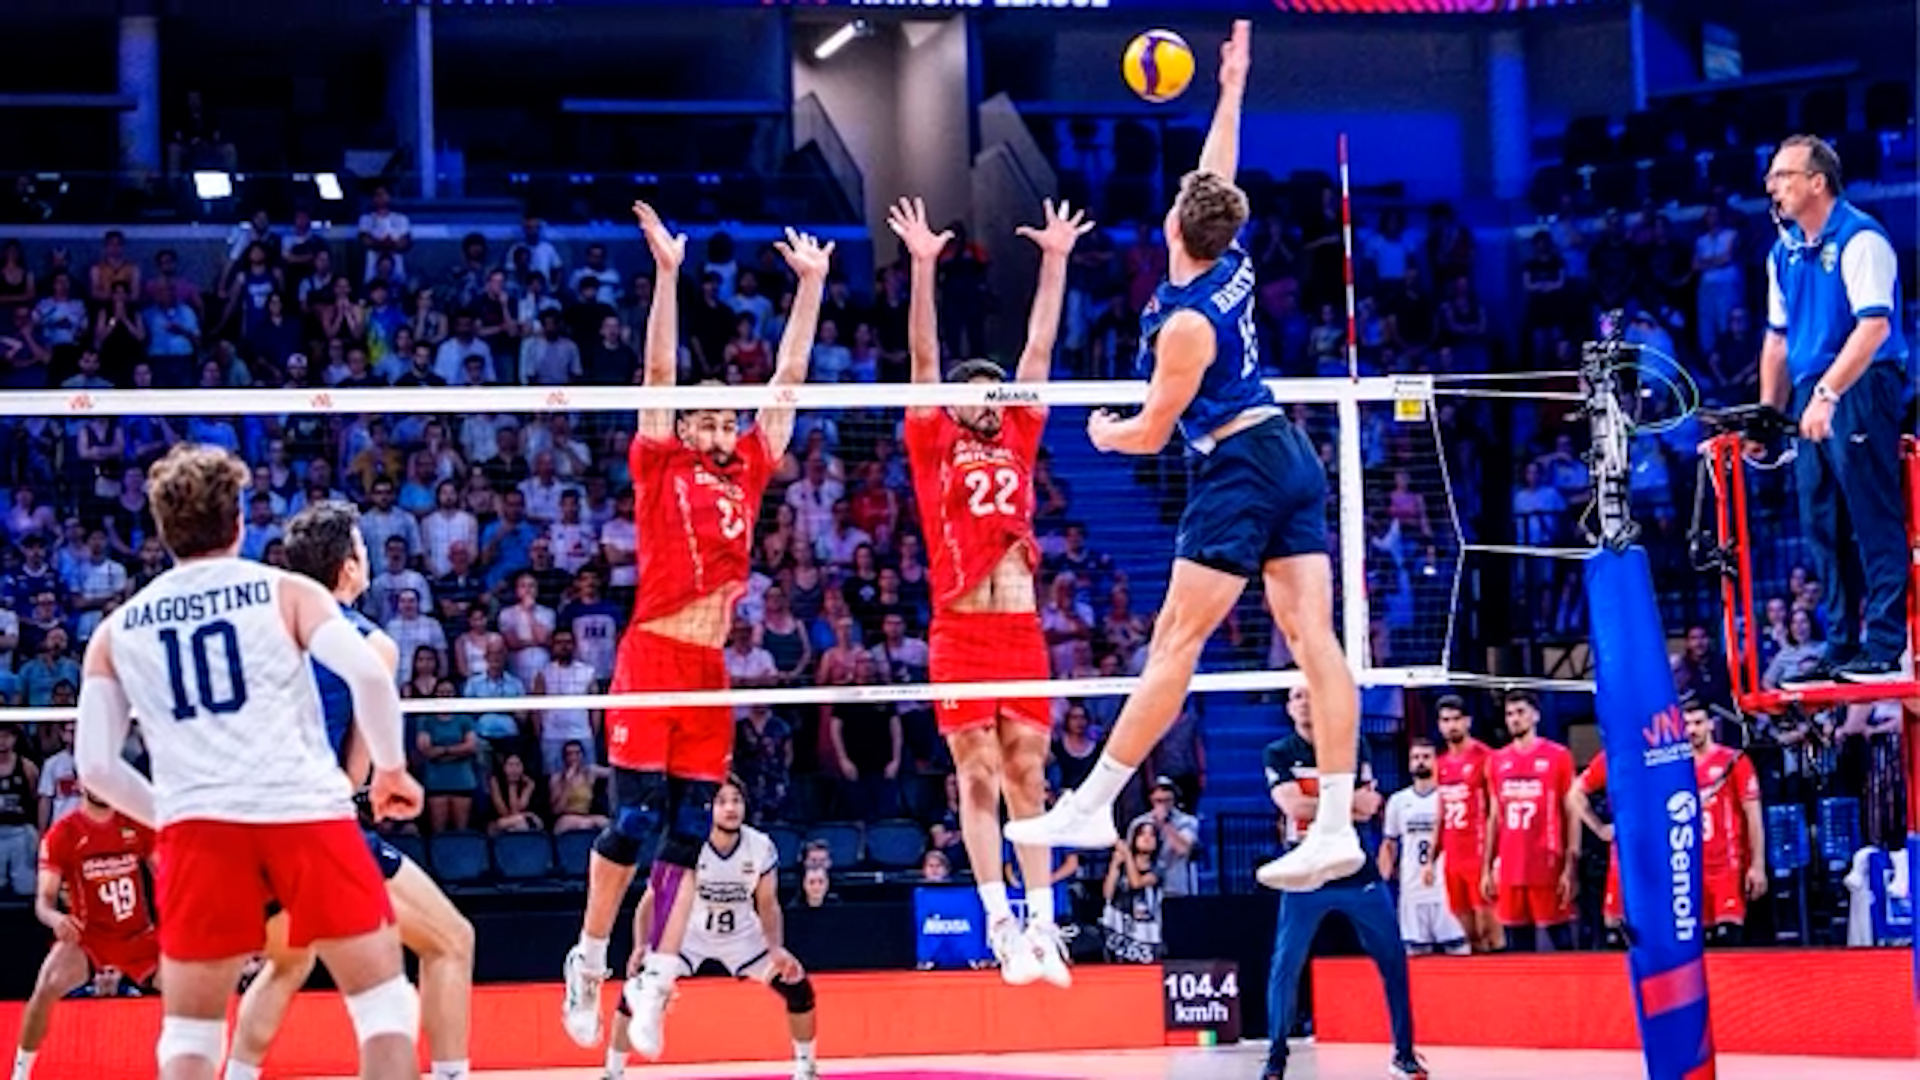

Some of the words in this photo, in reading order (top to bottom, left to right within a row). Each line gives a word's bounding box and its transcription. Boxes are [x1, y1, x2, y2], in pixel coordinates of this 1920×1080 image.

[964, 467, 1019, 516] 22
[123, 579, 271, 630] DAGOSTINO
[159, 619, 248, 722] 10
[1507, 801, 1537, 830] 67
[97, 876, 136, 922] 49
[1669, 824, 1697, 941] Senoh
[706, 909, 735, 934] 19
[1163, 972, 1238, 999] 104.4
[1174, 1000, 1229, 1022] km/h
